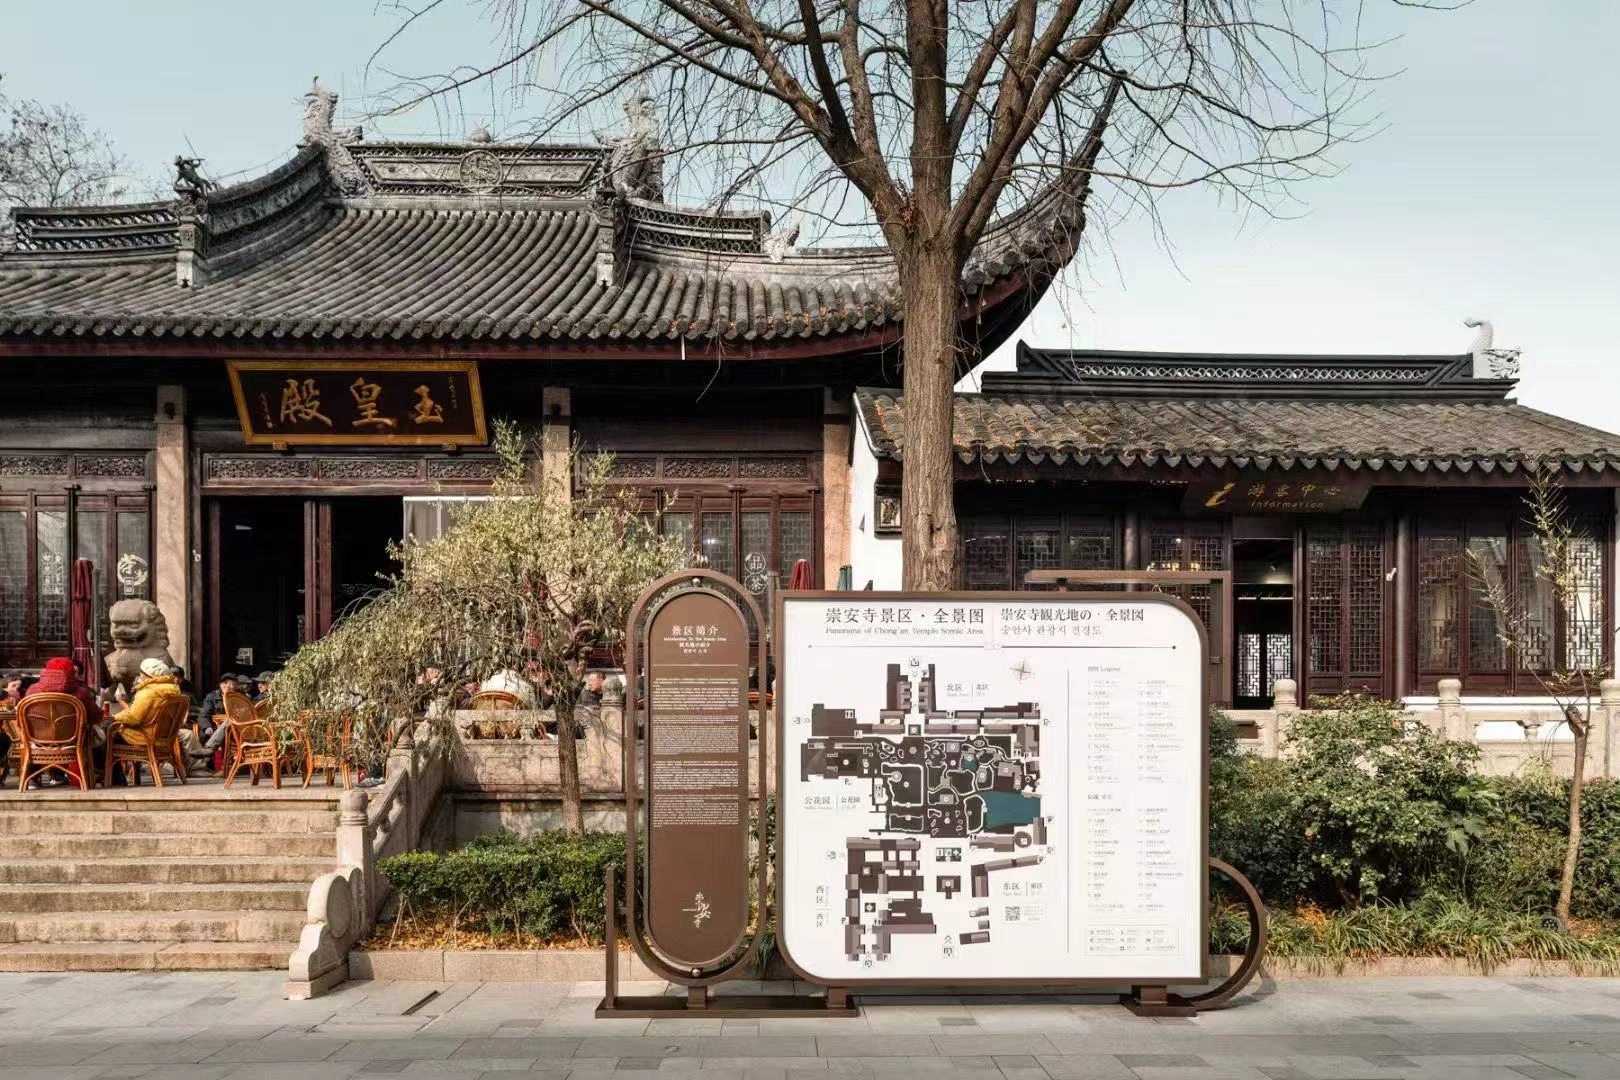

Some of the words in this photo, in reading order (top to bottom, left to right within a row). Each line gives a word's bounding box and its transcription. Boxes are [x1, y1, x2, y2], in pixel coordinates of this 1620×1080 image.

[672, 625, 718, 636] 景区简介
[913, 627, 939, 635] Temple
